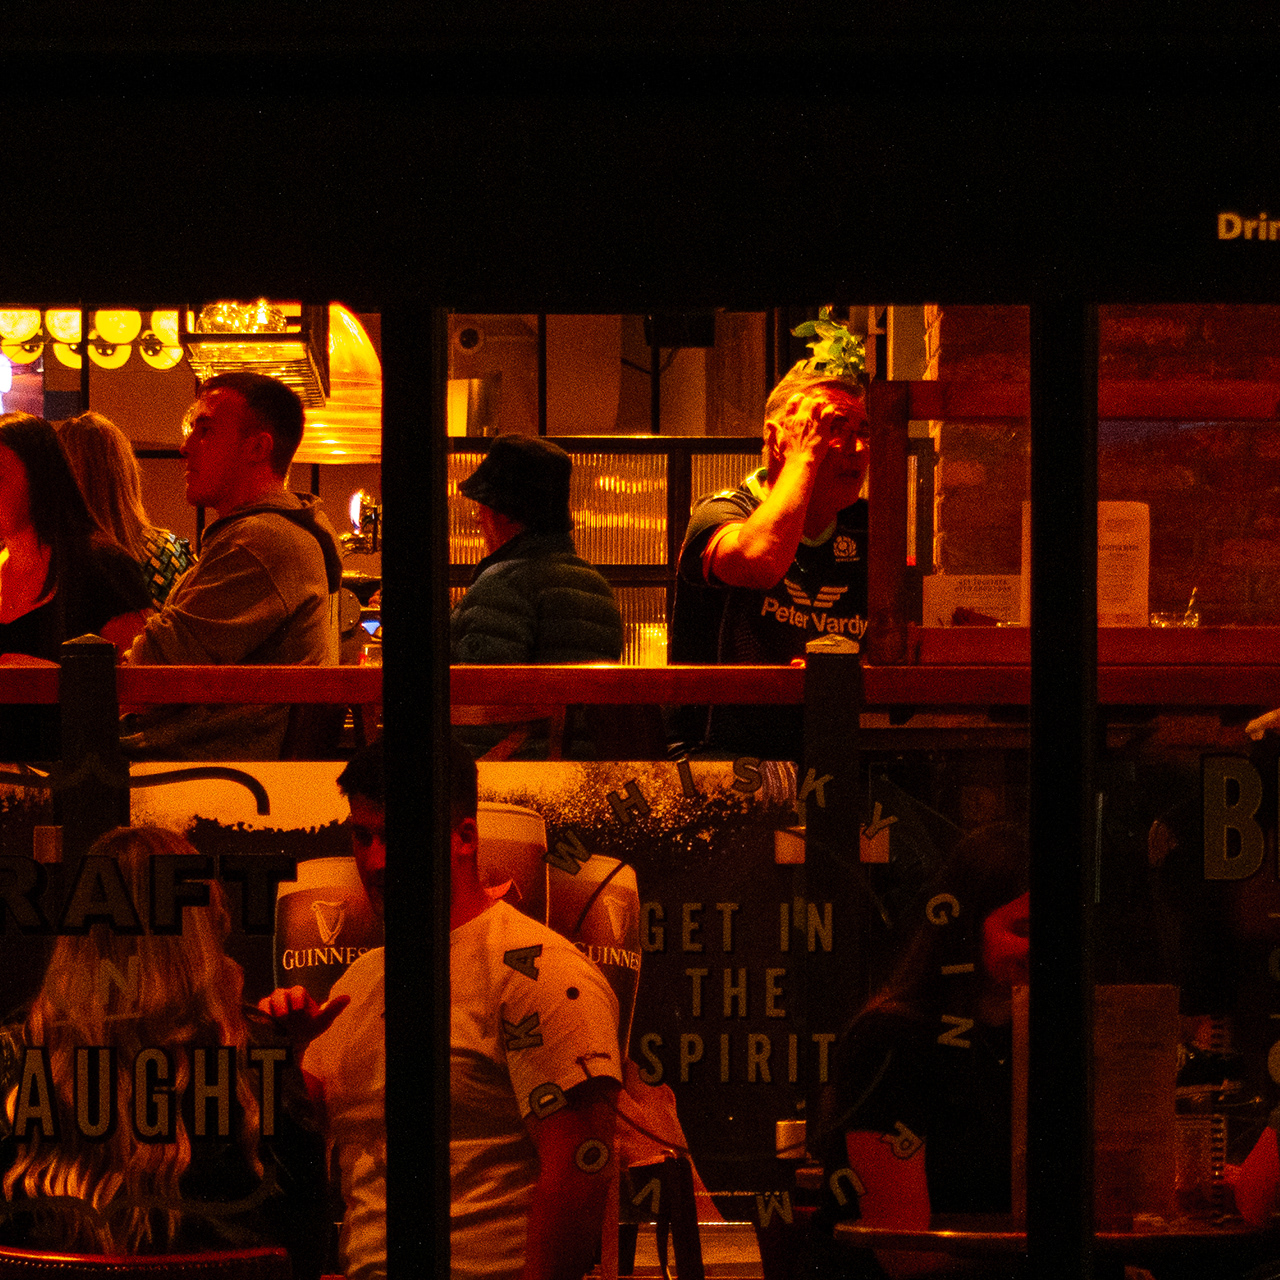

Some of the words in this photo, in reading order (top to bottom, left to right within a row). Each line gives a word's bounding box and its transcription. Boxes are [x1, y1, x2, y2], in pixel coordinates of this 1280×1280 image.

[760, 596, 810, 629] Peter
[810, 611, 868, 640] Vardy
[543, 756, 899, 875] WHISKY
[640, 900, 741, 953] GET
[780, 900, 835, 953] IN
[282, 946, 368, 971] GUINNES
[925, 892, 976, 1050] GIN
[685, 967, 788, 1020] THE
[639, 1032, 837, 1086] SPIRIT
